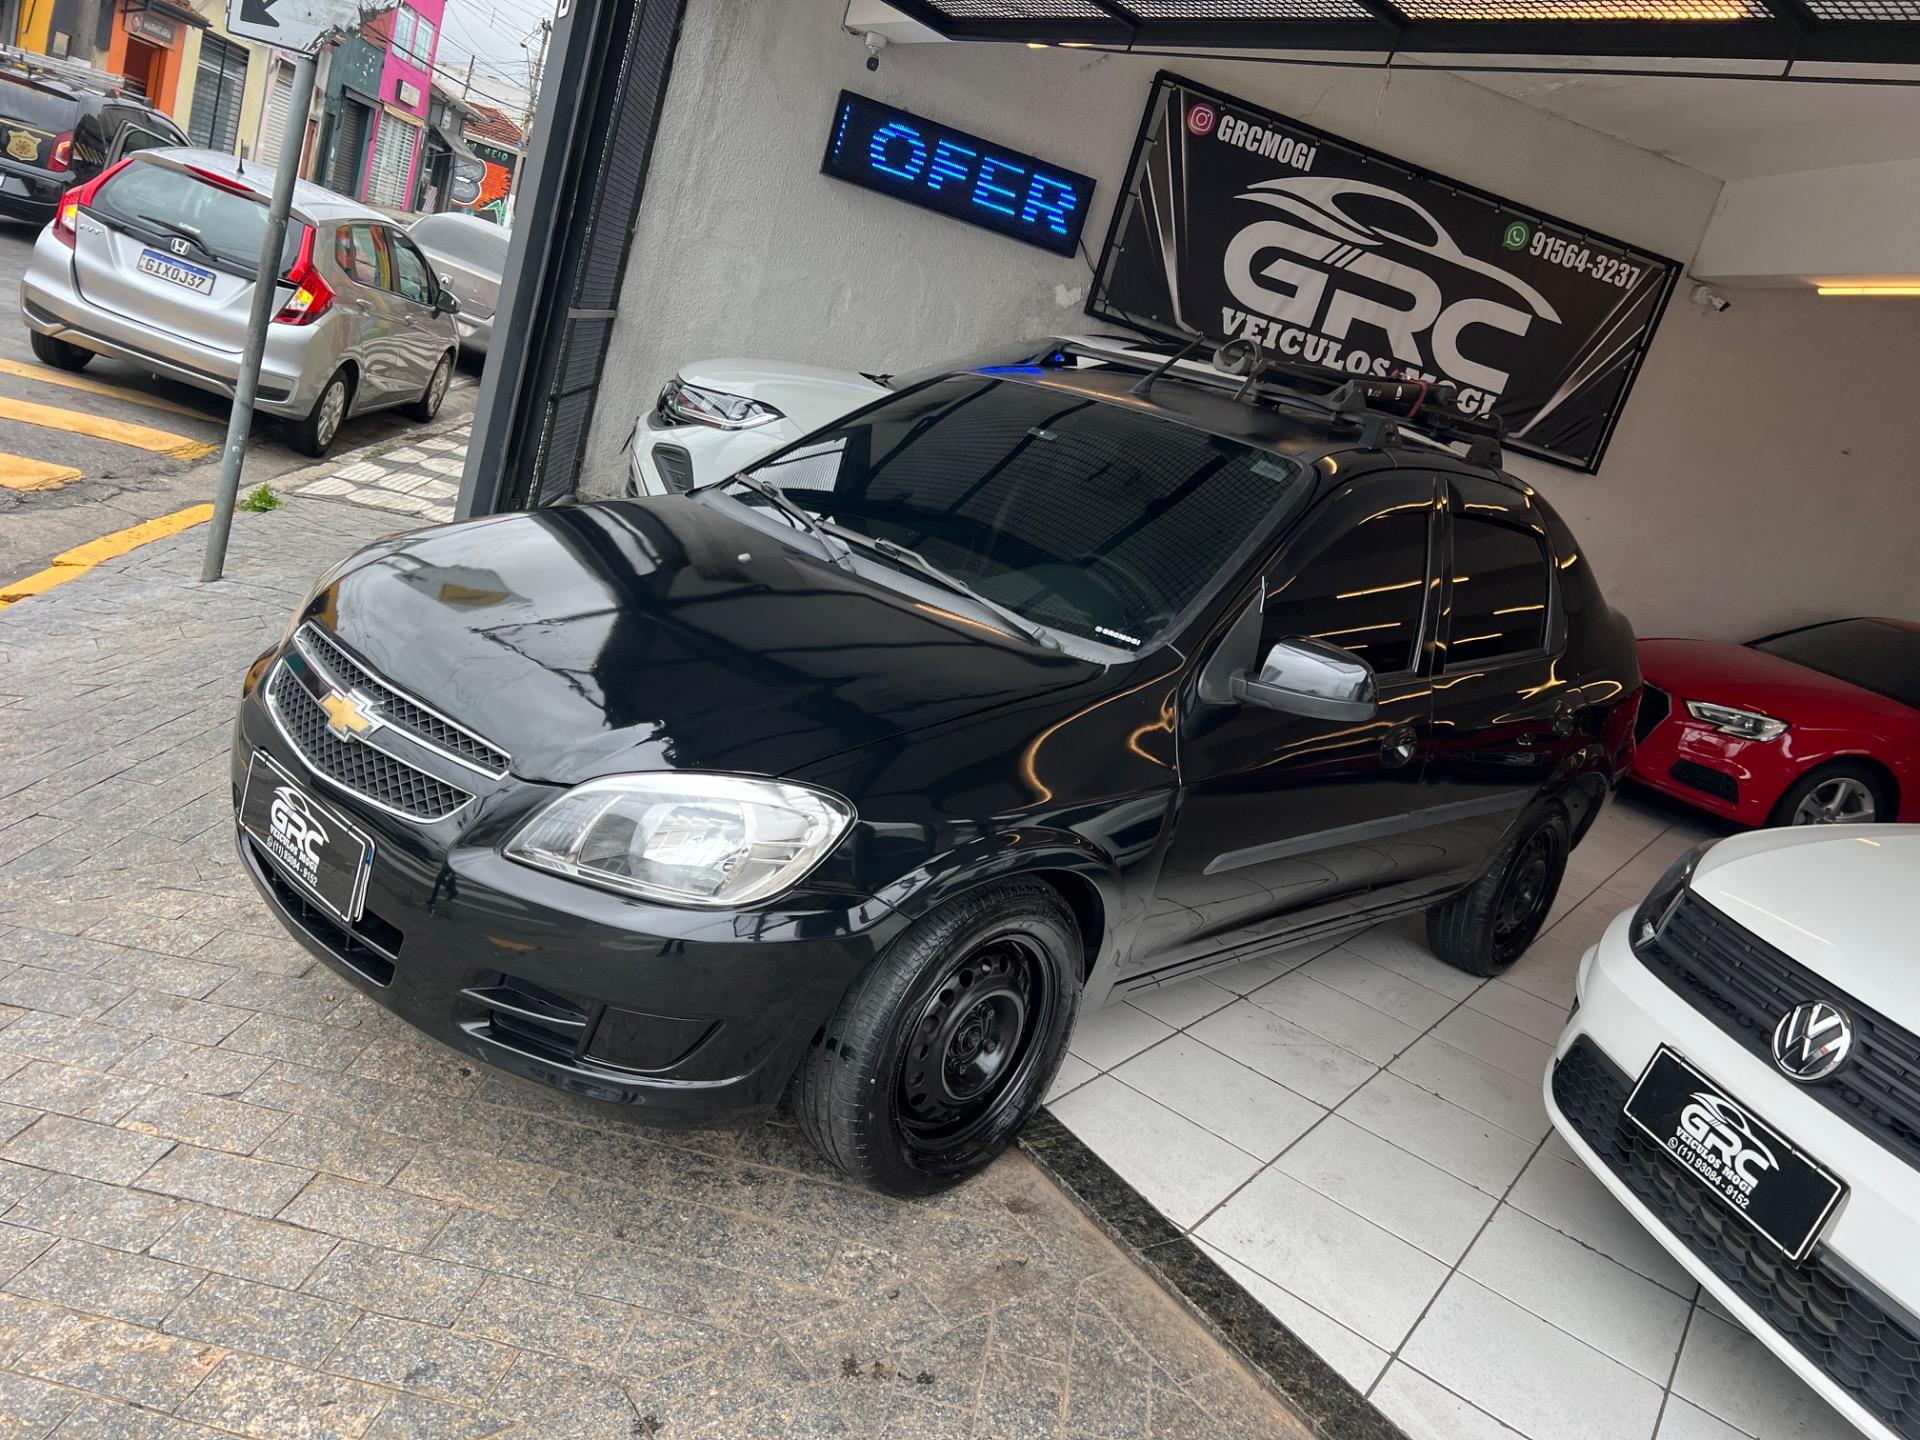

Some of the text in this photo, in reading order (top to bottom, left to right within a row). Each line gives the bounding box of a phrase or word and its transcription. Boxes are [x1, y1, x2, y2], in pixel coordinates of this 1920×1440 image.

[1217, 115, 1317, 172] GRCMOGI
[870, 120, 1077, 234] OFER
[1529, 232, 1641, 291] 91564-3237
[1223, 220, 1533, 395] GRC
[1222, 307, 1391, 379] VEICULOS
[270, 824, 318, 874] VEICULOS MOGI
[271, 799, 324, 865] GRC
[273, 840, 284, 858] (11)
[303, 868, 318, 887] 9152
[1676, 1126, 1753, 1196] VEICULOS MOGI
[1677, 1144, 1695, 1164] (11)
[1694, 1158, 1722, 1185] 93084
[1725, 1185, 1749, 1209] 9152
[1681, 1104, 1770, 1188] GRC
